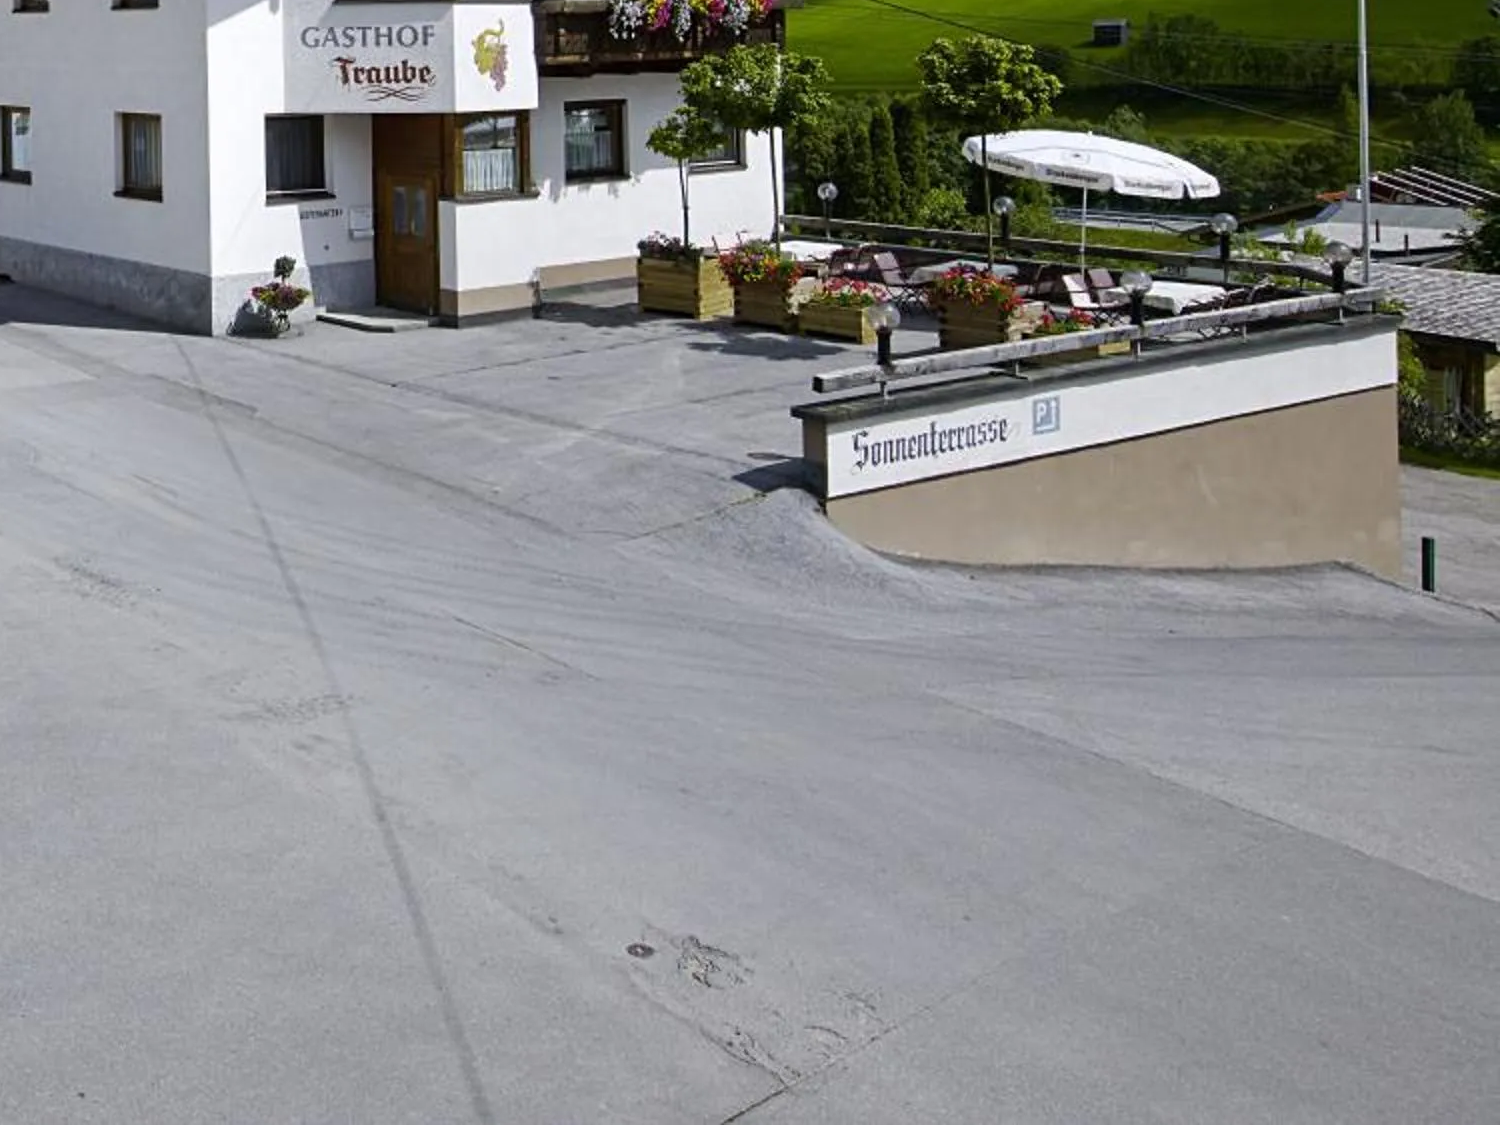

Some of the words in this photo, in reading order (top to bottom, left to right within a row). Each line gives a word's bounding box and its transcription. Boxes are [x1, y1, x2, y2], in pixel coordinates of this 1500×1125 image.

[300, 24, 435, 48] GASTHOF
[331, 55, 436, 87] Traube
[851, 418, 1010, 470] Sonnenterrasse
